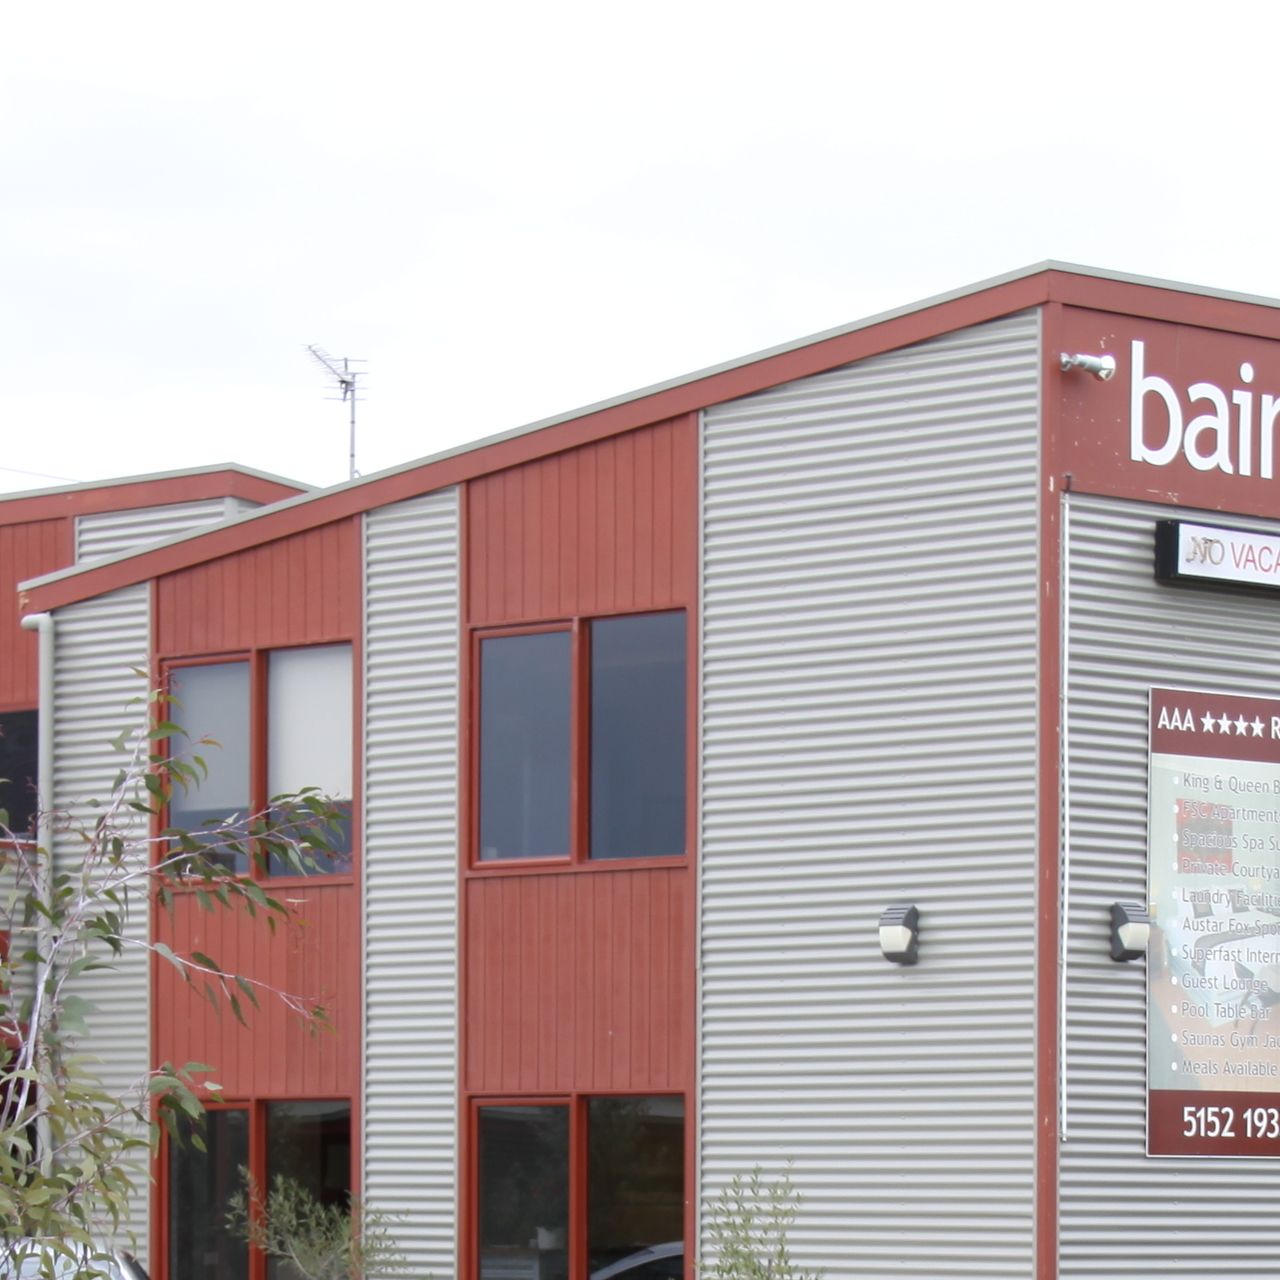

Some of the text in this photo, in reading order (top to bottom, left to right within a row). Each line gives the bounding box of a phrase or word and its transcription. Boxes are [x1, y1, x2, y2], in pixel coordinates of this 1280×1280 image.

[1185, 536, 1225, 566] NO
[1157, 706, 1196, 732] AAA
[1183, 773, 1209, 793] King
[1214, 775, 1223, 791] &
[1228, 776, 1270, 794] Queen
[1183, 829, 1238, 850] Spacious
[1242, 833, 1265, 852] Spa
[1182, 857, 1227, 876] Private
[1182, 888, 1231, 908] Laundry
[1182, 917, 1224, 932] Austar
[1228, 918, 1250, 934] Fox
[1182, 944, 1242, 965] Superfast
[1181, 973, 1268, 995] Guest Lounge
[1181, 1002, 1271, 1019] Pool Table Bar
[1182, 1030, 1226, 1046] Saunas
[1230, 1031, 1258, 1049] Gym
[1182, 1060, 1278, 1076] Meals Available
[1183, 1106, 1235, 1137] 5152
